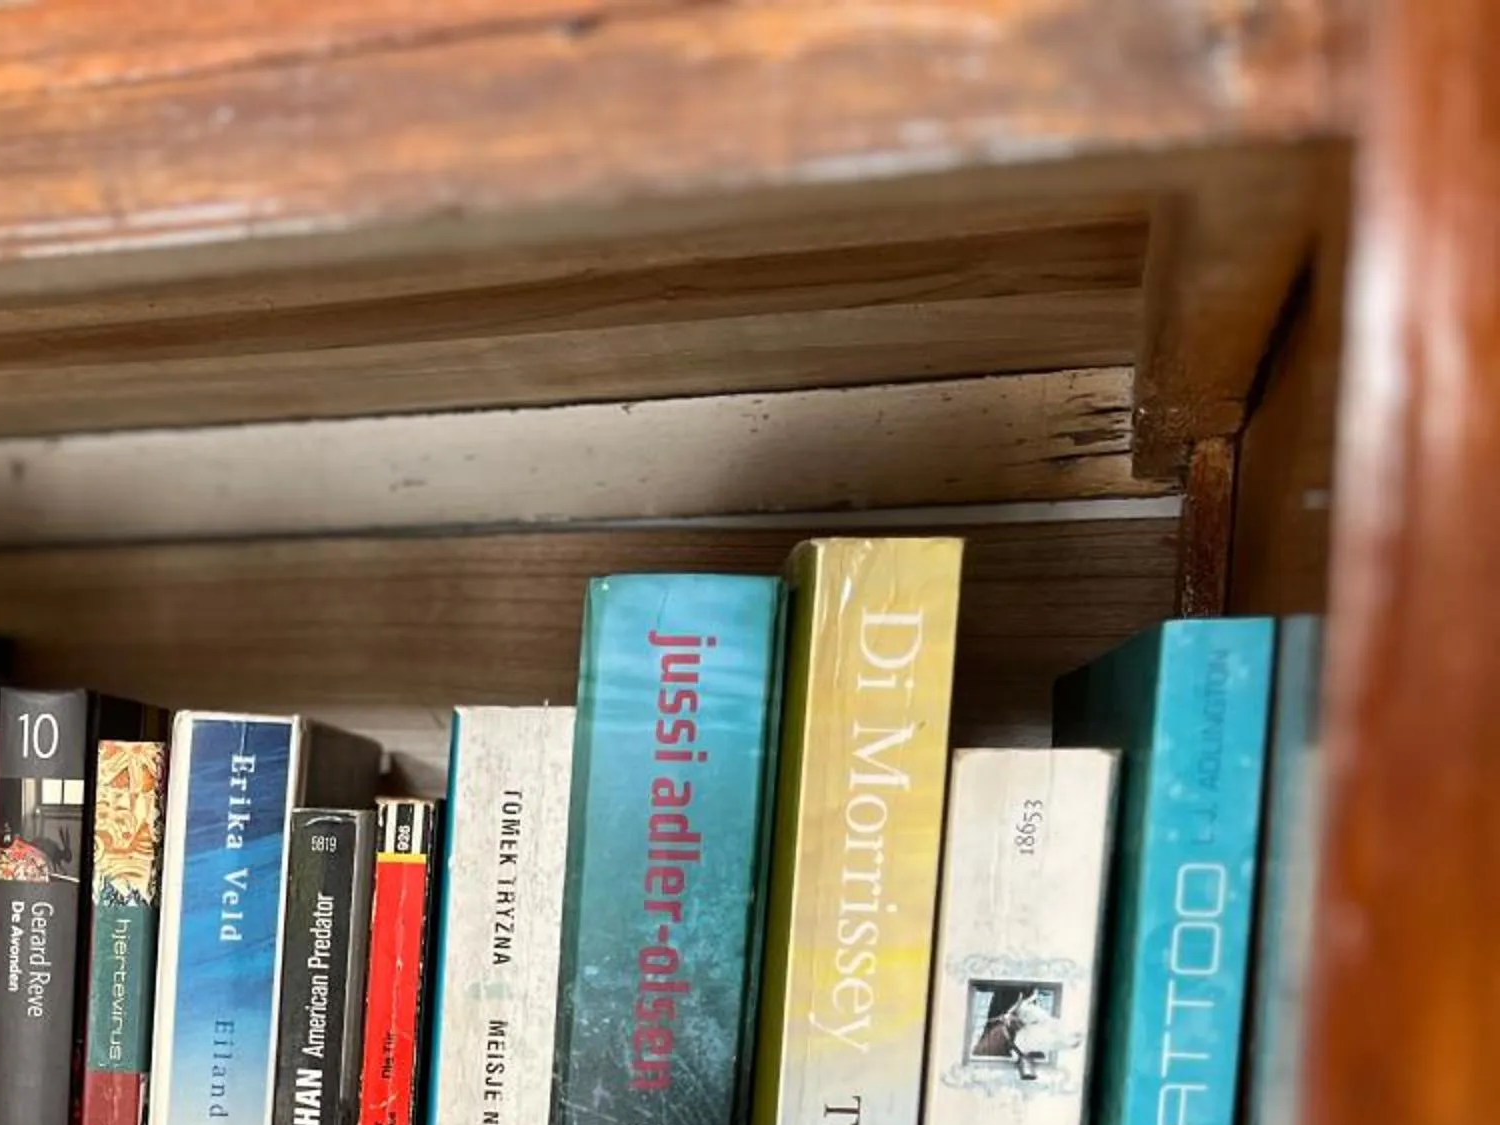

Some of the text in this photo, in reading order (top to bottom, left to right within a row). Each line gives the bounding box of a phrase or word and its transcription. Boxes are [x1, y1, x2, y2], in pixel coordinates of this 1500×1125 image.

[18, 712, 60, 759] 10
[1202, 648, 1229, 792] ADLINGTON
[219, 754, 256, 942] Erika Veld
[311, 836, 337, 853] 5819
[630, 630, 717, 1091] jussi adler-olsen
[808, 606, 924, 1053] Di Morrissey
[1014, 799, 1043, 856] 18653
[491, 789, 522, 966] TOMEK TRYZNA
[8, 901, 25, 992] De Avonden
[27, 901, 55, 1018] Gerard Reve
[307, 891, 335, 970] Predator
[109, 917, 131, 1061] hjertevirus
[302, 972, 329, 1060] American
[208, 1019, 235, 1118] Eiland
[484, 1019, 508, 1102] MEISJE
